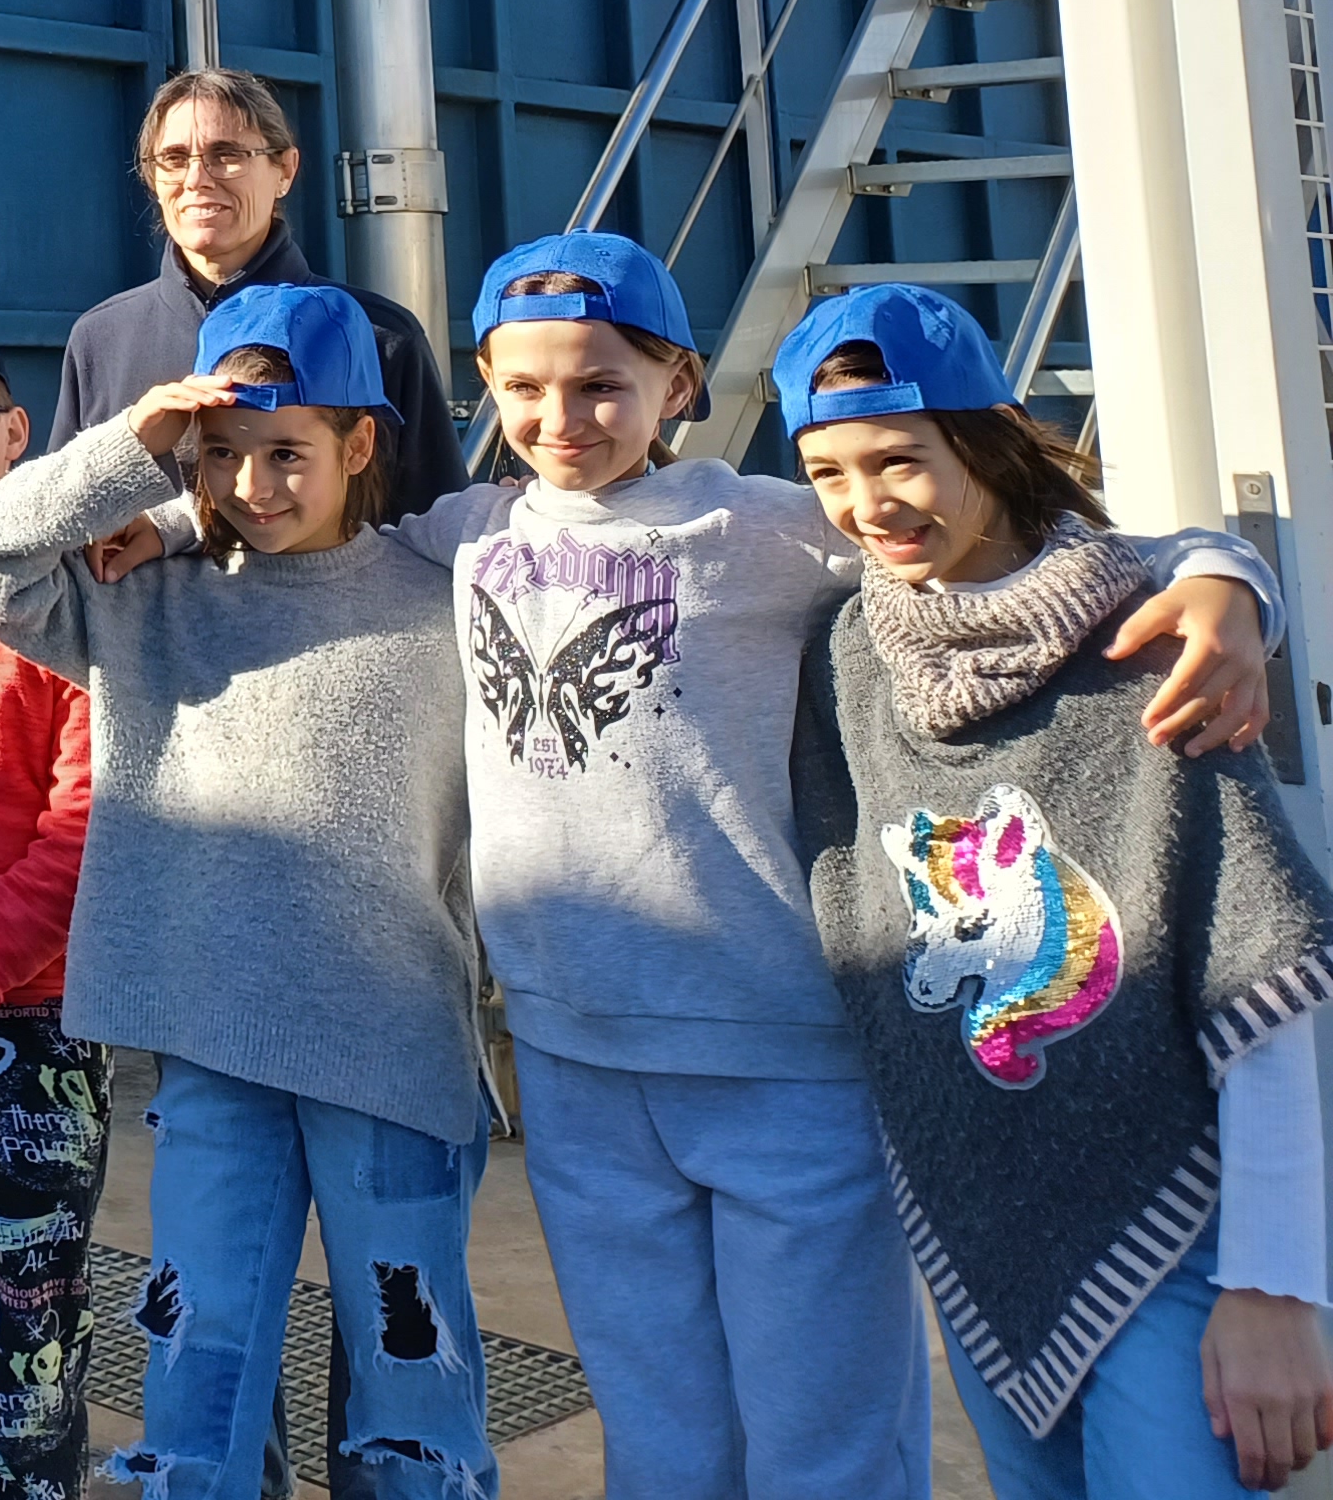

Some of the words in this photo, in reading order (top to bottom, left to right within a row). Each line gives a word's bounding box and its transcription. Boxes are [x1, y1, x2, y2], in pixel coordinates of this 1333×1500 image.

[533, 736, 558, 755] est
[528, 756, 569, 781] 1974
[18, 1249, 60, 1276] ALL
